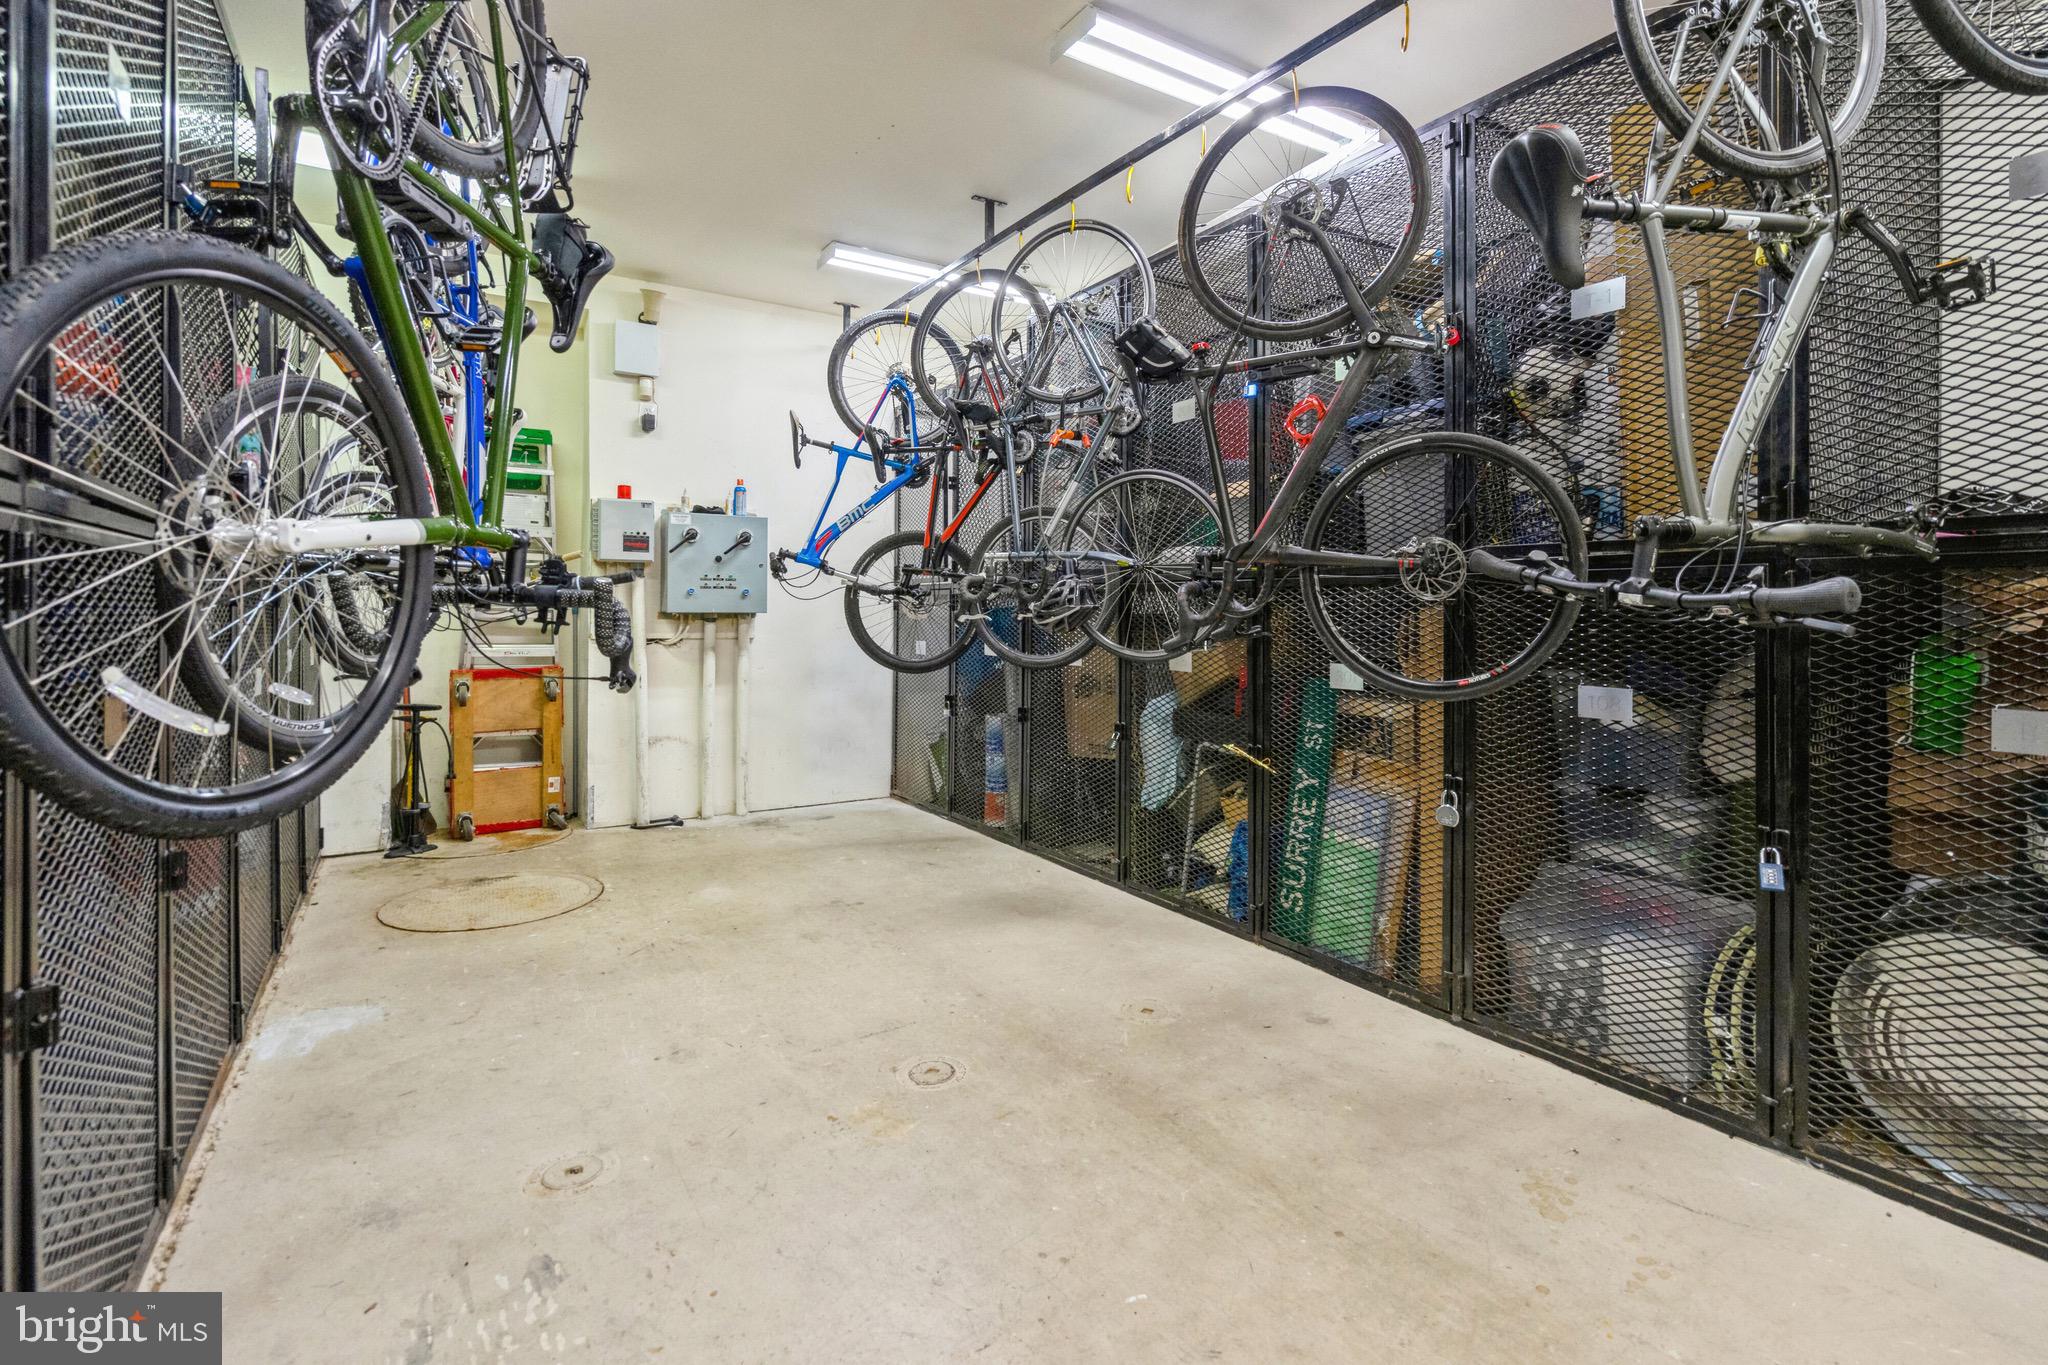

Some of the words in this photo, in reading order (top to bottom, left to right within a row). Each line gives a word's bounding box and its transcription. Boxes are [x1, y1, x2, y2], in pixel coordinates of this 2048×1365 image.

[1737, 314, 1798, 444] MARIN
[836, 498, 875, 531] BMC
[1280, 768, 1319, 913] SURREY
[1303, 719, 1326, 751] ST
